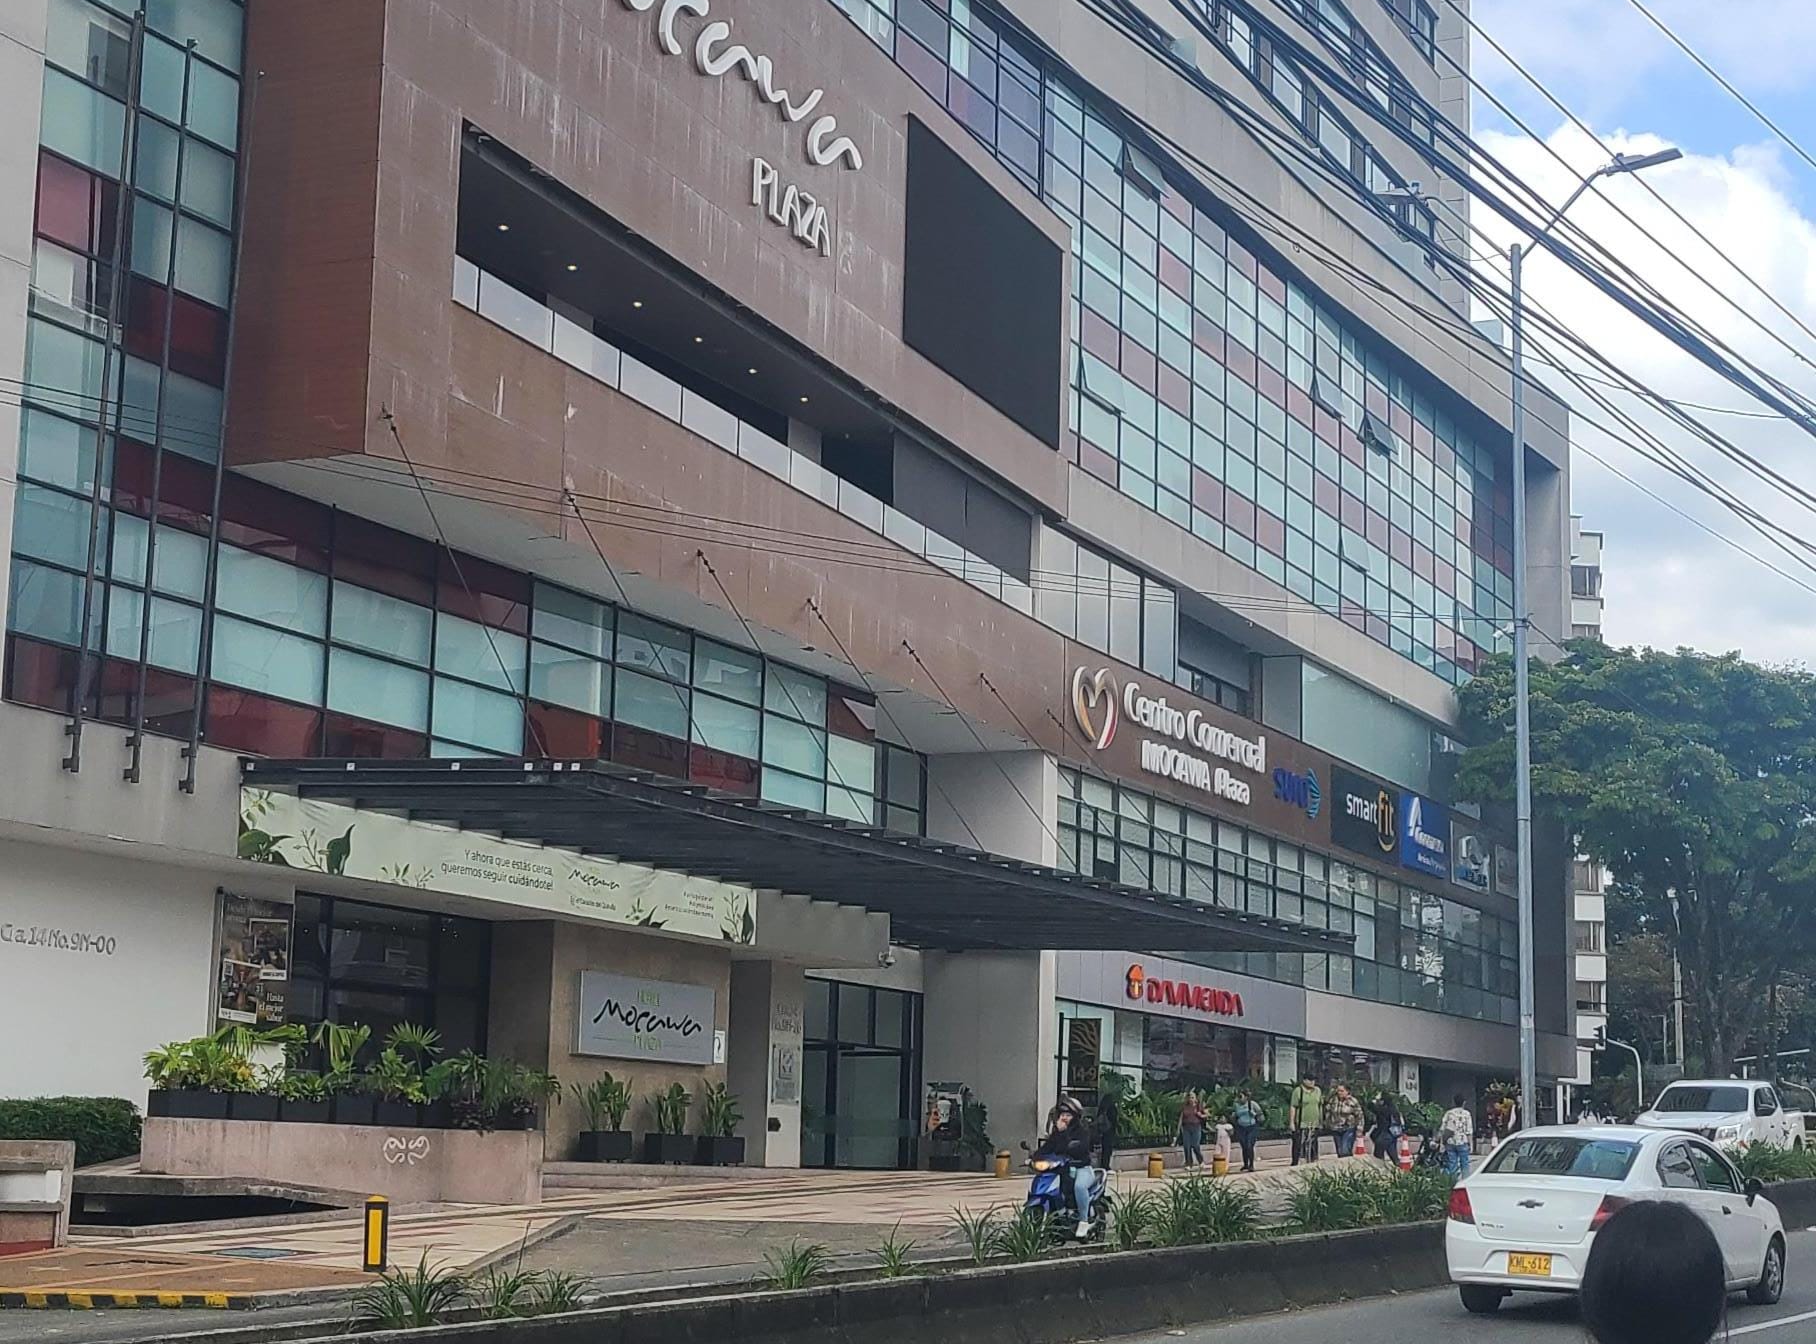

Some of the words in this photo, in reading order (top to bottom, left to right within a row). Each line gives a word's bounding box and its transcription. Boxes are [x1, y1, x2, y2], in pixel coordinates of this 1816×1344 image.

[752, 157, 831, 258] PLAZA
[1123, 682, 1186, 740] Centro
[1187, 710, 1266, 774] Comercial
[1141, 739, 1211, 792] MOCAWA
[1214, 767, 1250, 805] Plaza
[441, 862, 482, 878] queremos
[483, 869, 507, 883] seguir
[464, 849, 471, 860] Y
[471, 851, 494, 865] ahora
[495, 856, 511, 867] que
